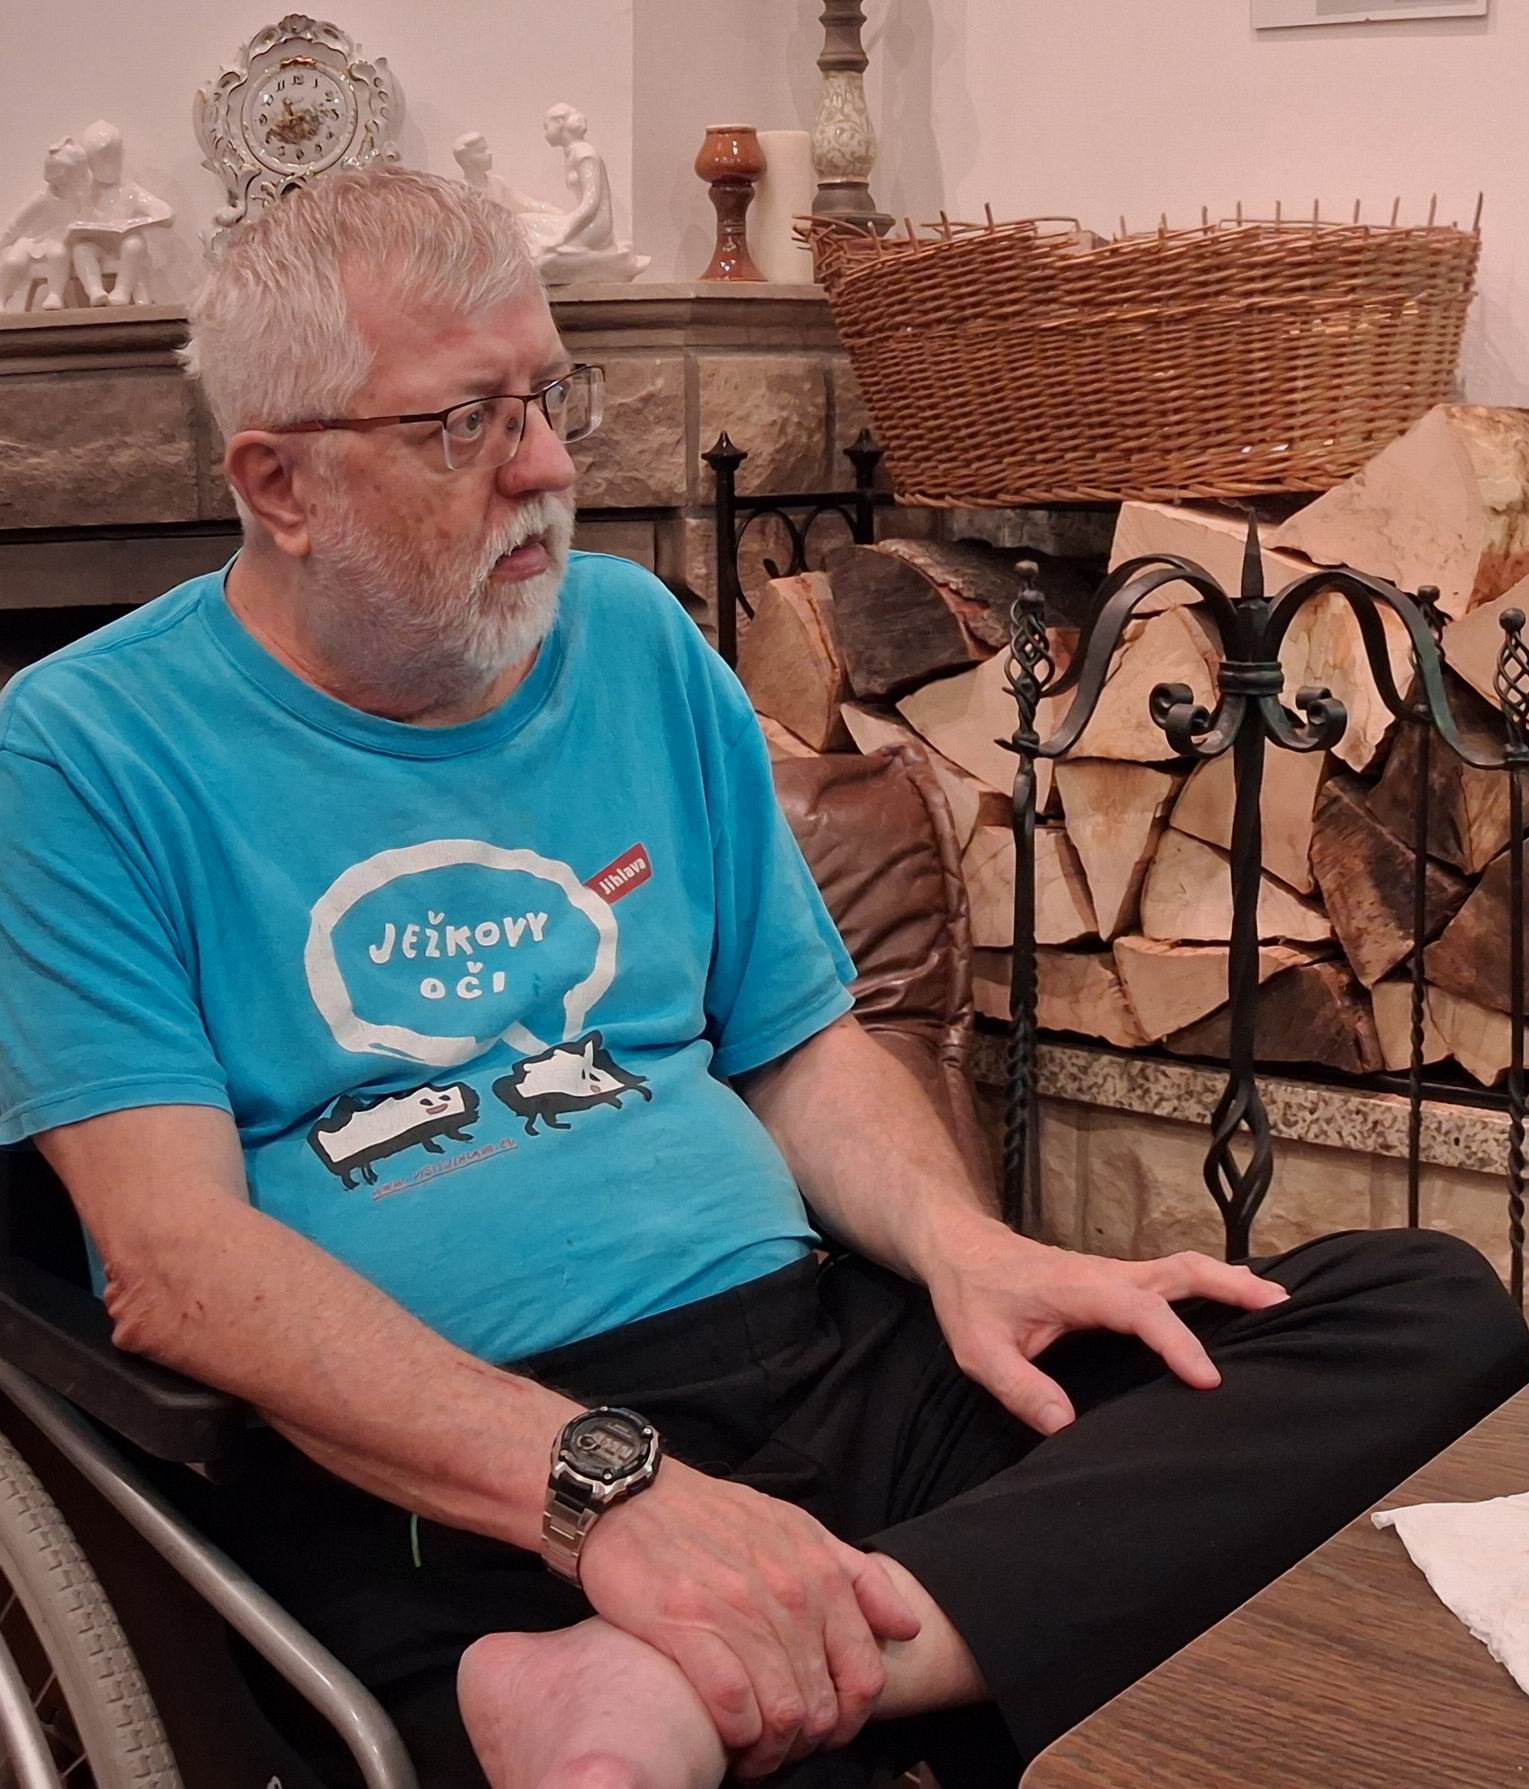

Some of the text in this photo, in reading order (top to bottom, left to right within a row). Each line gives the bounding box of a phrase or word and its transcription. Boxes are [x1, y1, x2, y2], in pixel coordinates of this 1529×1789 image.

[598, 856, 648, 895] Jihlava
[368, 910, 548, 964] JEŽKOVY
[419, 961, 506, 1000] OČI
